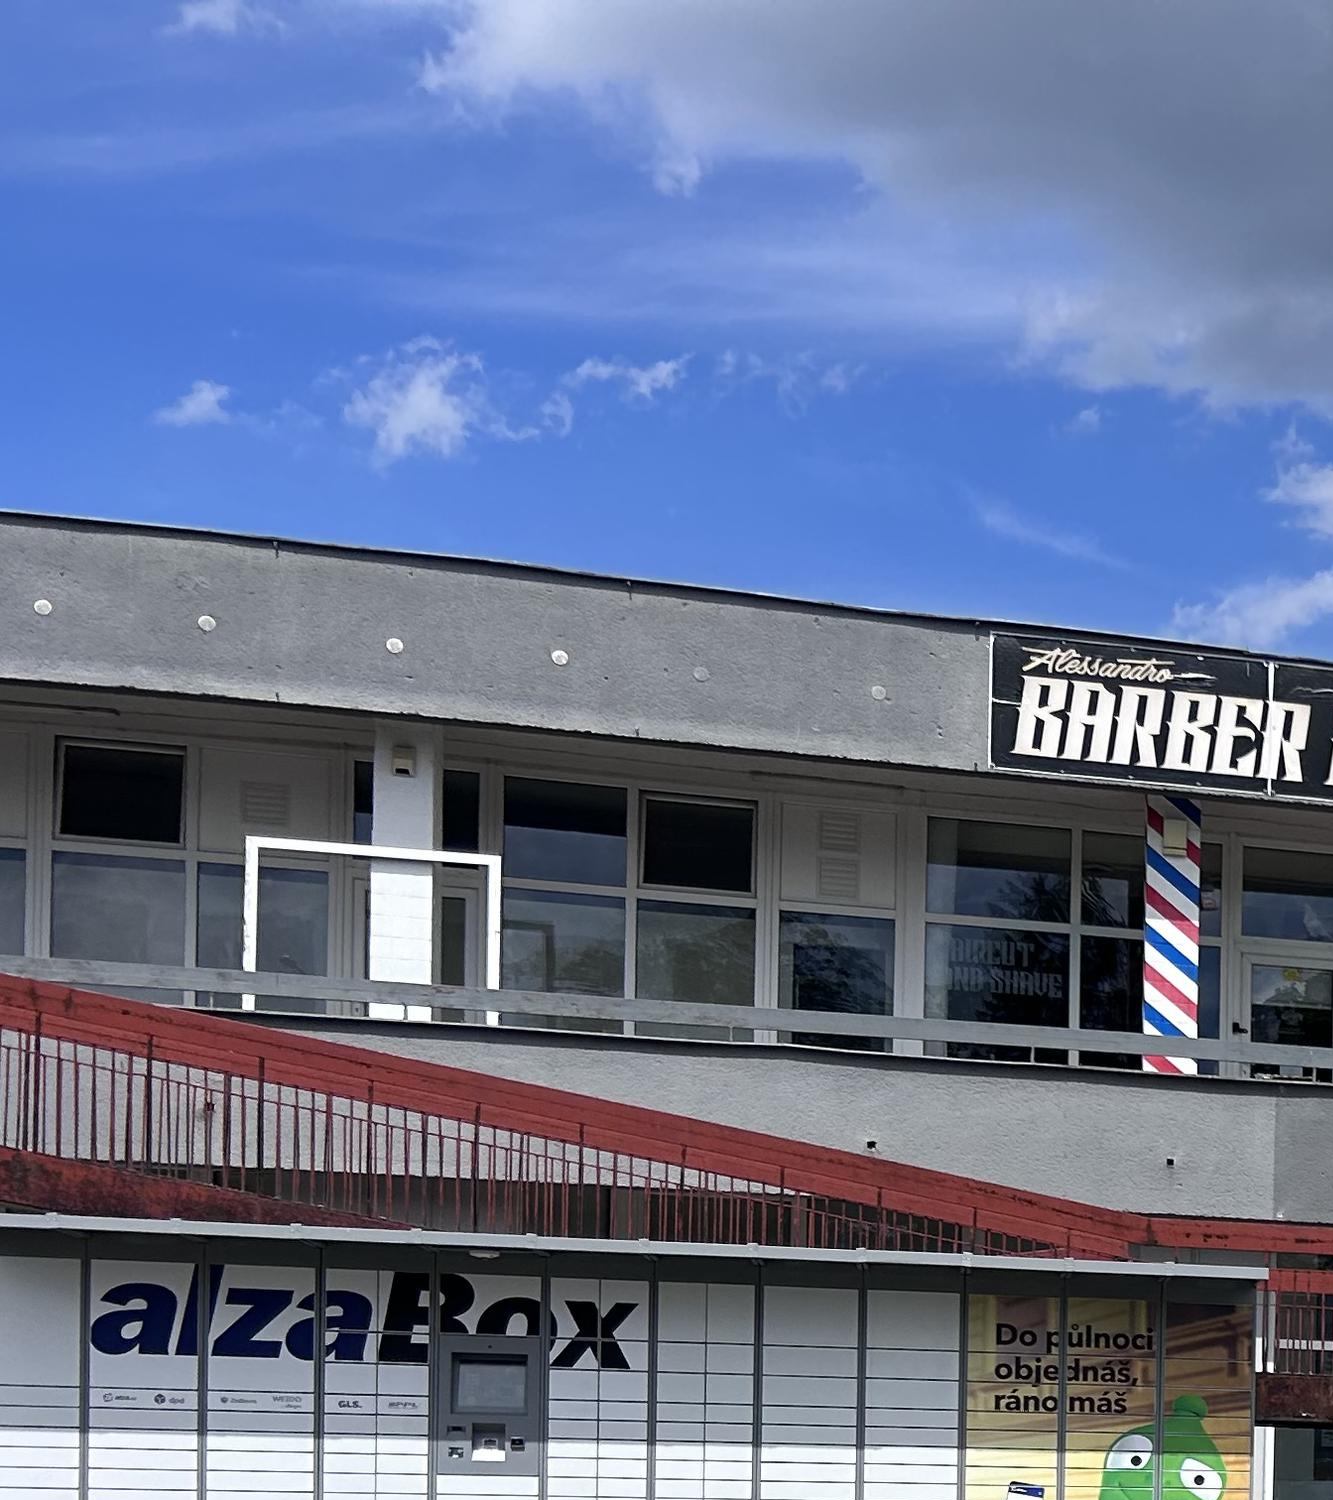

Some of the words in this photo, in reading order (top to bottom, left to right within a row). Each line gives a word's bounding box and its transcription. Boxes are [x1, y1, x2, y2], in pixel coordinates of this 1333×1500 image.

[1022, 647, 1174, 684] Alessandro
[1011, 675, 1311, 782] BARBER
[950, 937, 1036, 968] AIRCUT
[91, 1264, 639, 1370] alzaBox
[996, 1323, 1038, 1347] Do
[1046, 1323, 1154, 1354] půlnoci
[994, 1356, 1139, 1388] objednáš,
[994, 1388, 1058, 1412] ráno
[1068, 1391, 1128, 1413] máš
